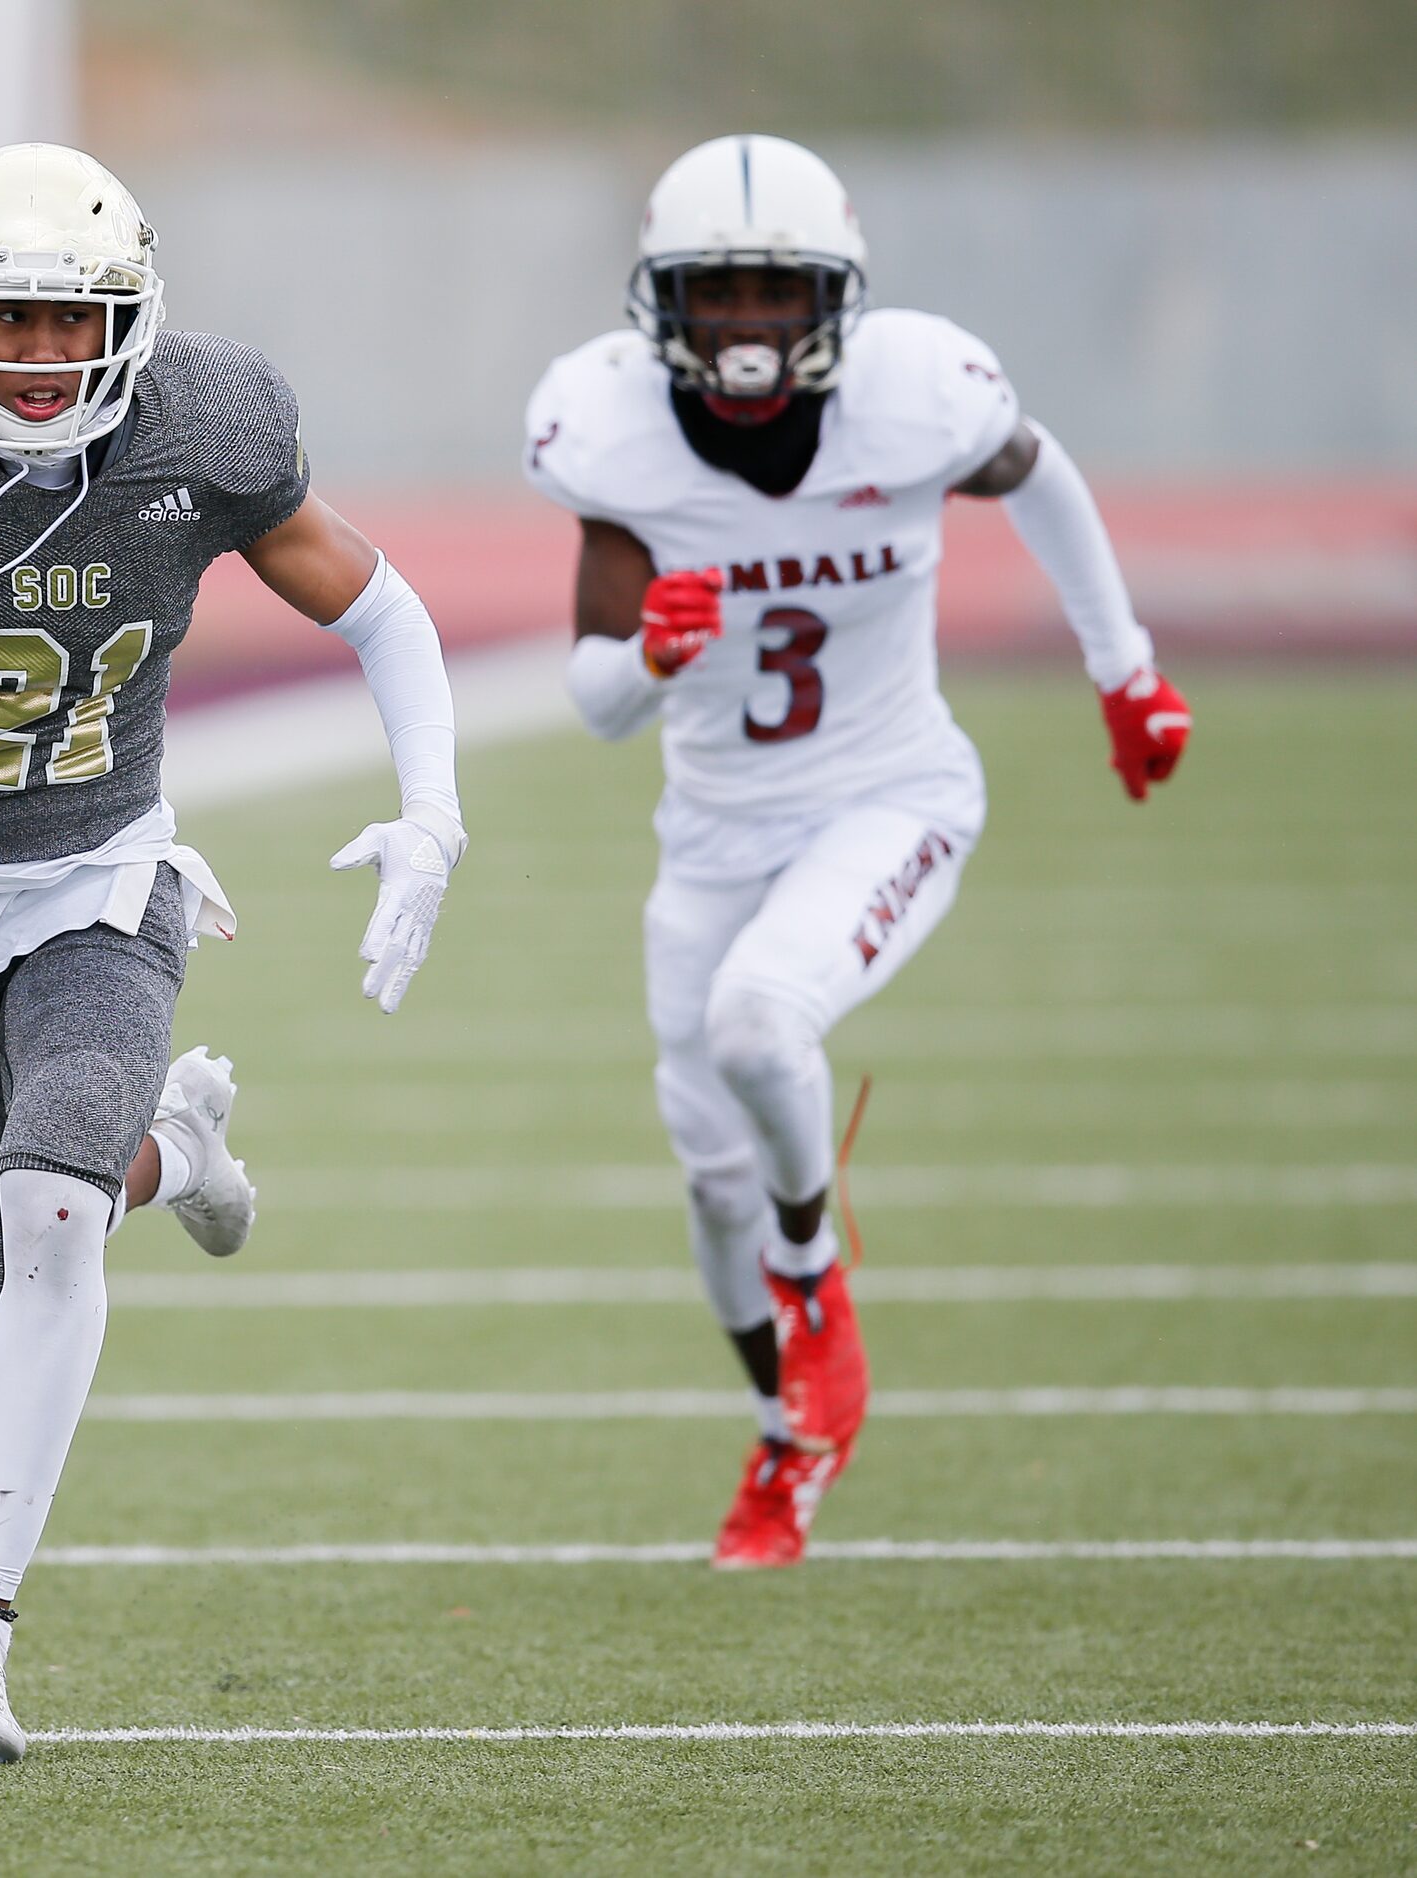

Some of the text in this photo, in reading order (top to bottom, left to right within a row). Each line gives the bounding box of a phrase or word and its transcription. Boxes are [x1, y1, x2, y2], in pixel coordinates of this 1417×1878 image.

[137, 507, 201, 522] adidas
[11, 562, 112, 612] SOC
[728, 545, 902, 592] MBALL
[743, 605, 829, 745] 3
